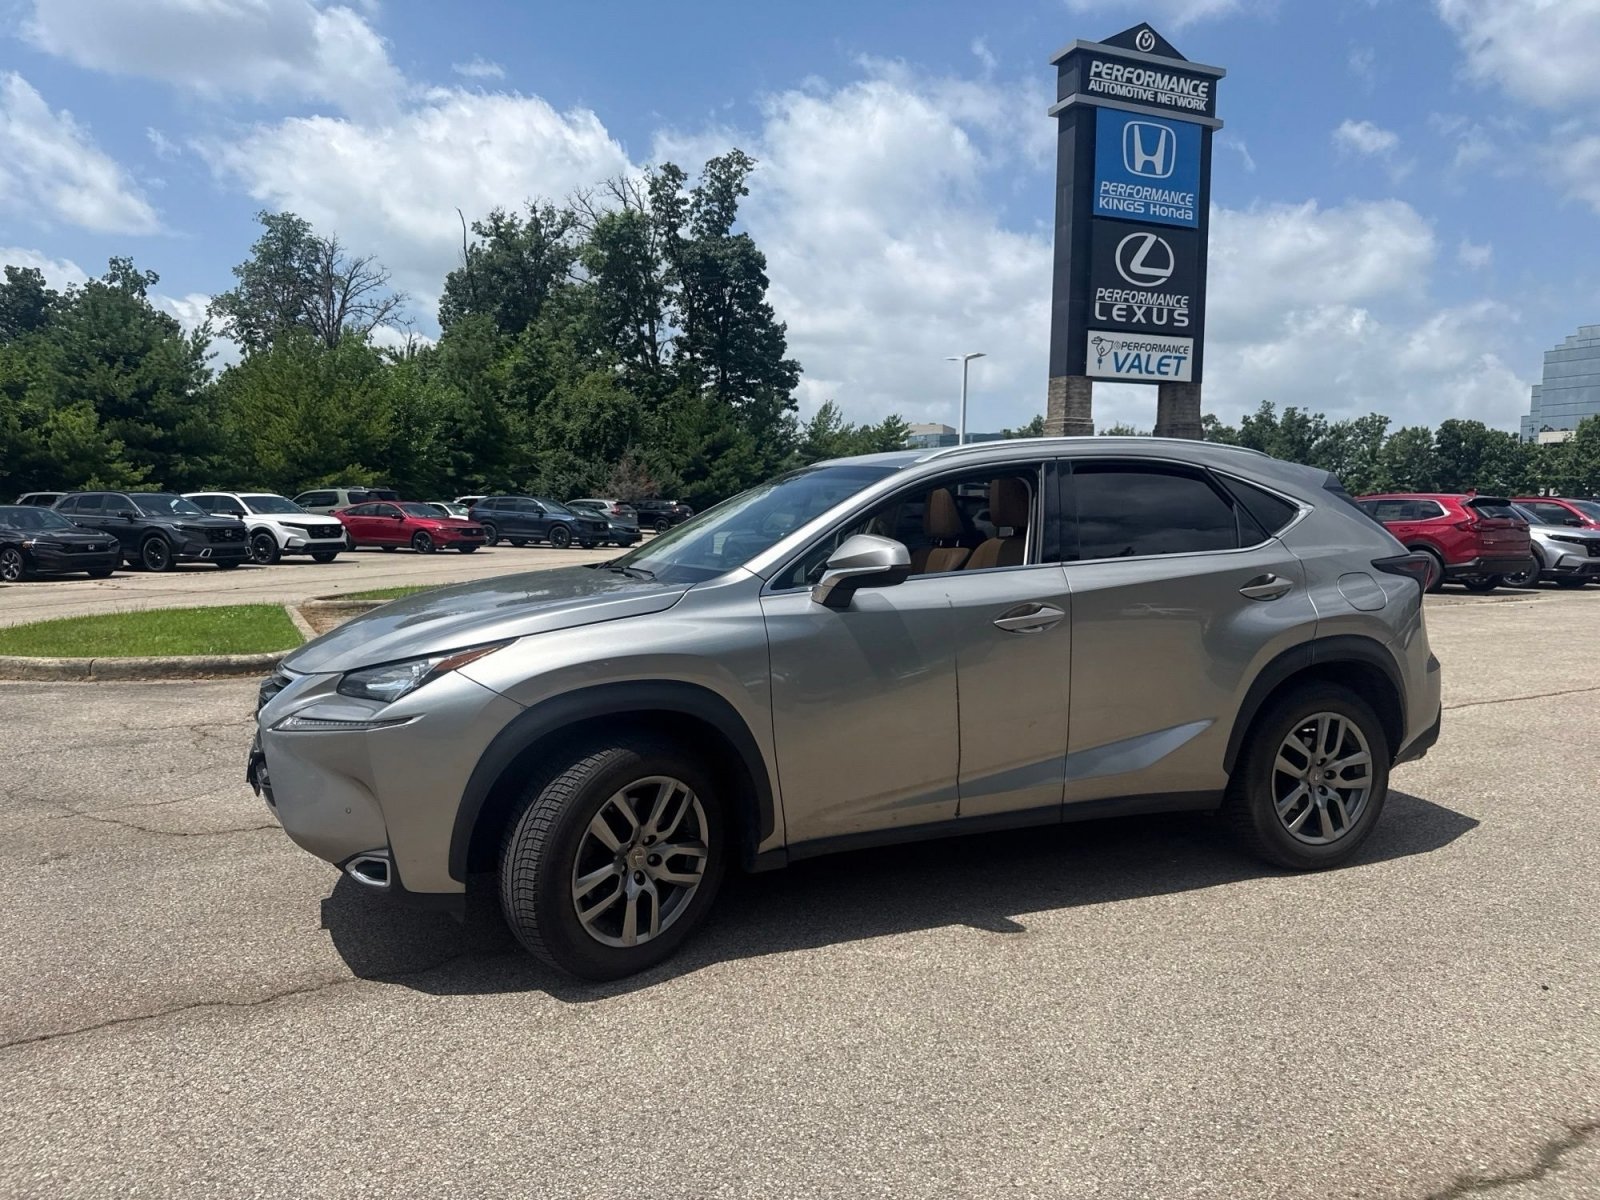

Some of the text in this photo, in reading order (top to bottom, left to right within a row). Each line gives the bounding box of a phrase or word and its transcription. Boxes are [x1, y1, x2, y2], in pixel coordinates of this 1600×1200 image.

[1089, 60, 1209, 97] PERFORMANCE
[1088, 79, 1207, 111] AUTOMOTIVE NETWORK
[1100, 181, 1194, 206] PERFORMANCE
[1099, 196, 1193, 220] KINGS Honda
[1095, 288, 1189, 308] PERFORMANCE
[1094, 301, 1189, 327] LEXUS
[1120, 341, 1190, 354] PERFORMANCE
[1113, 352, 1187, 376] VALET
